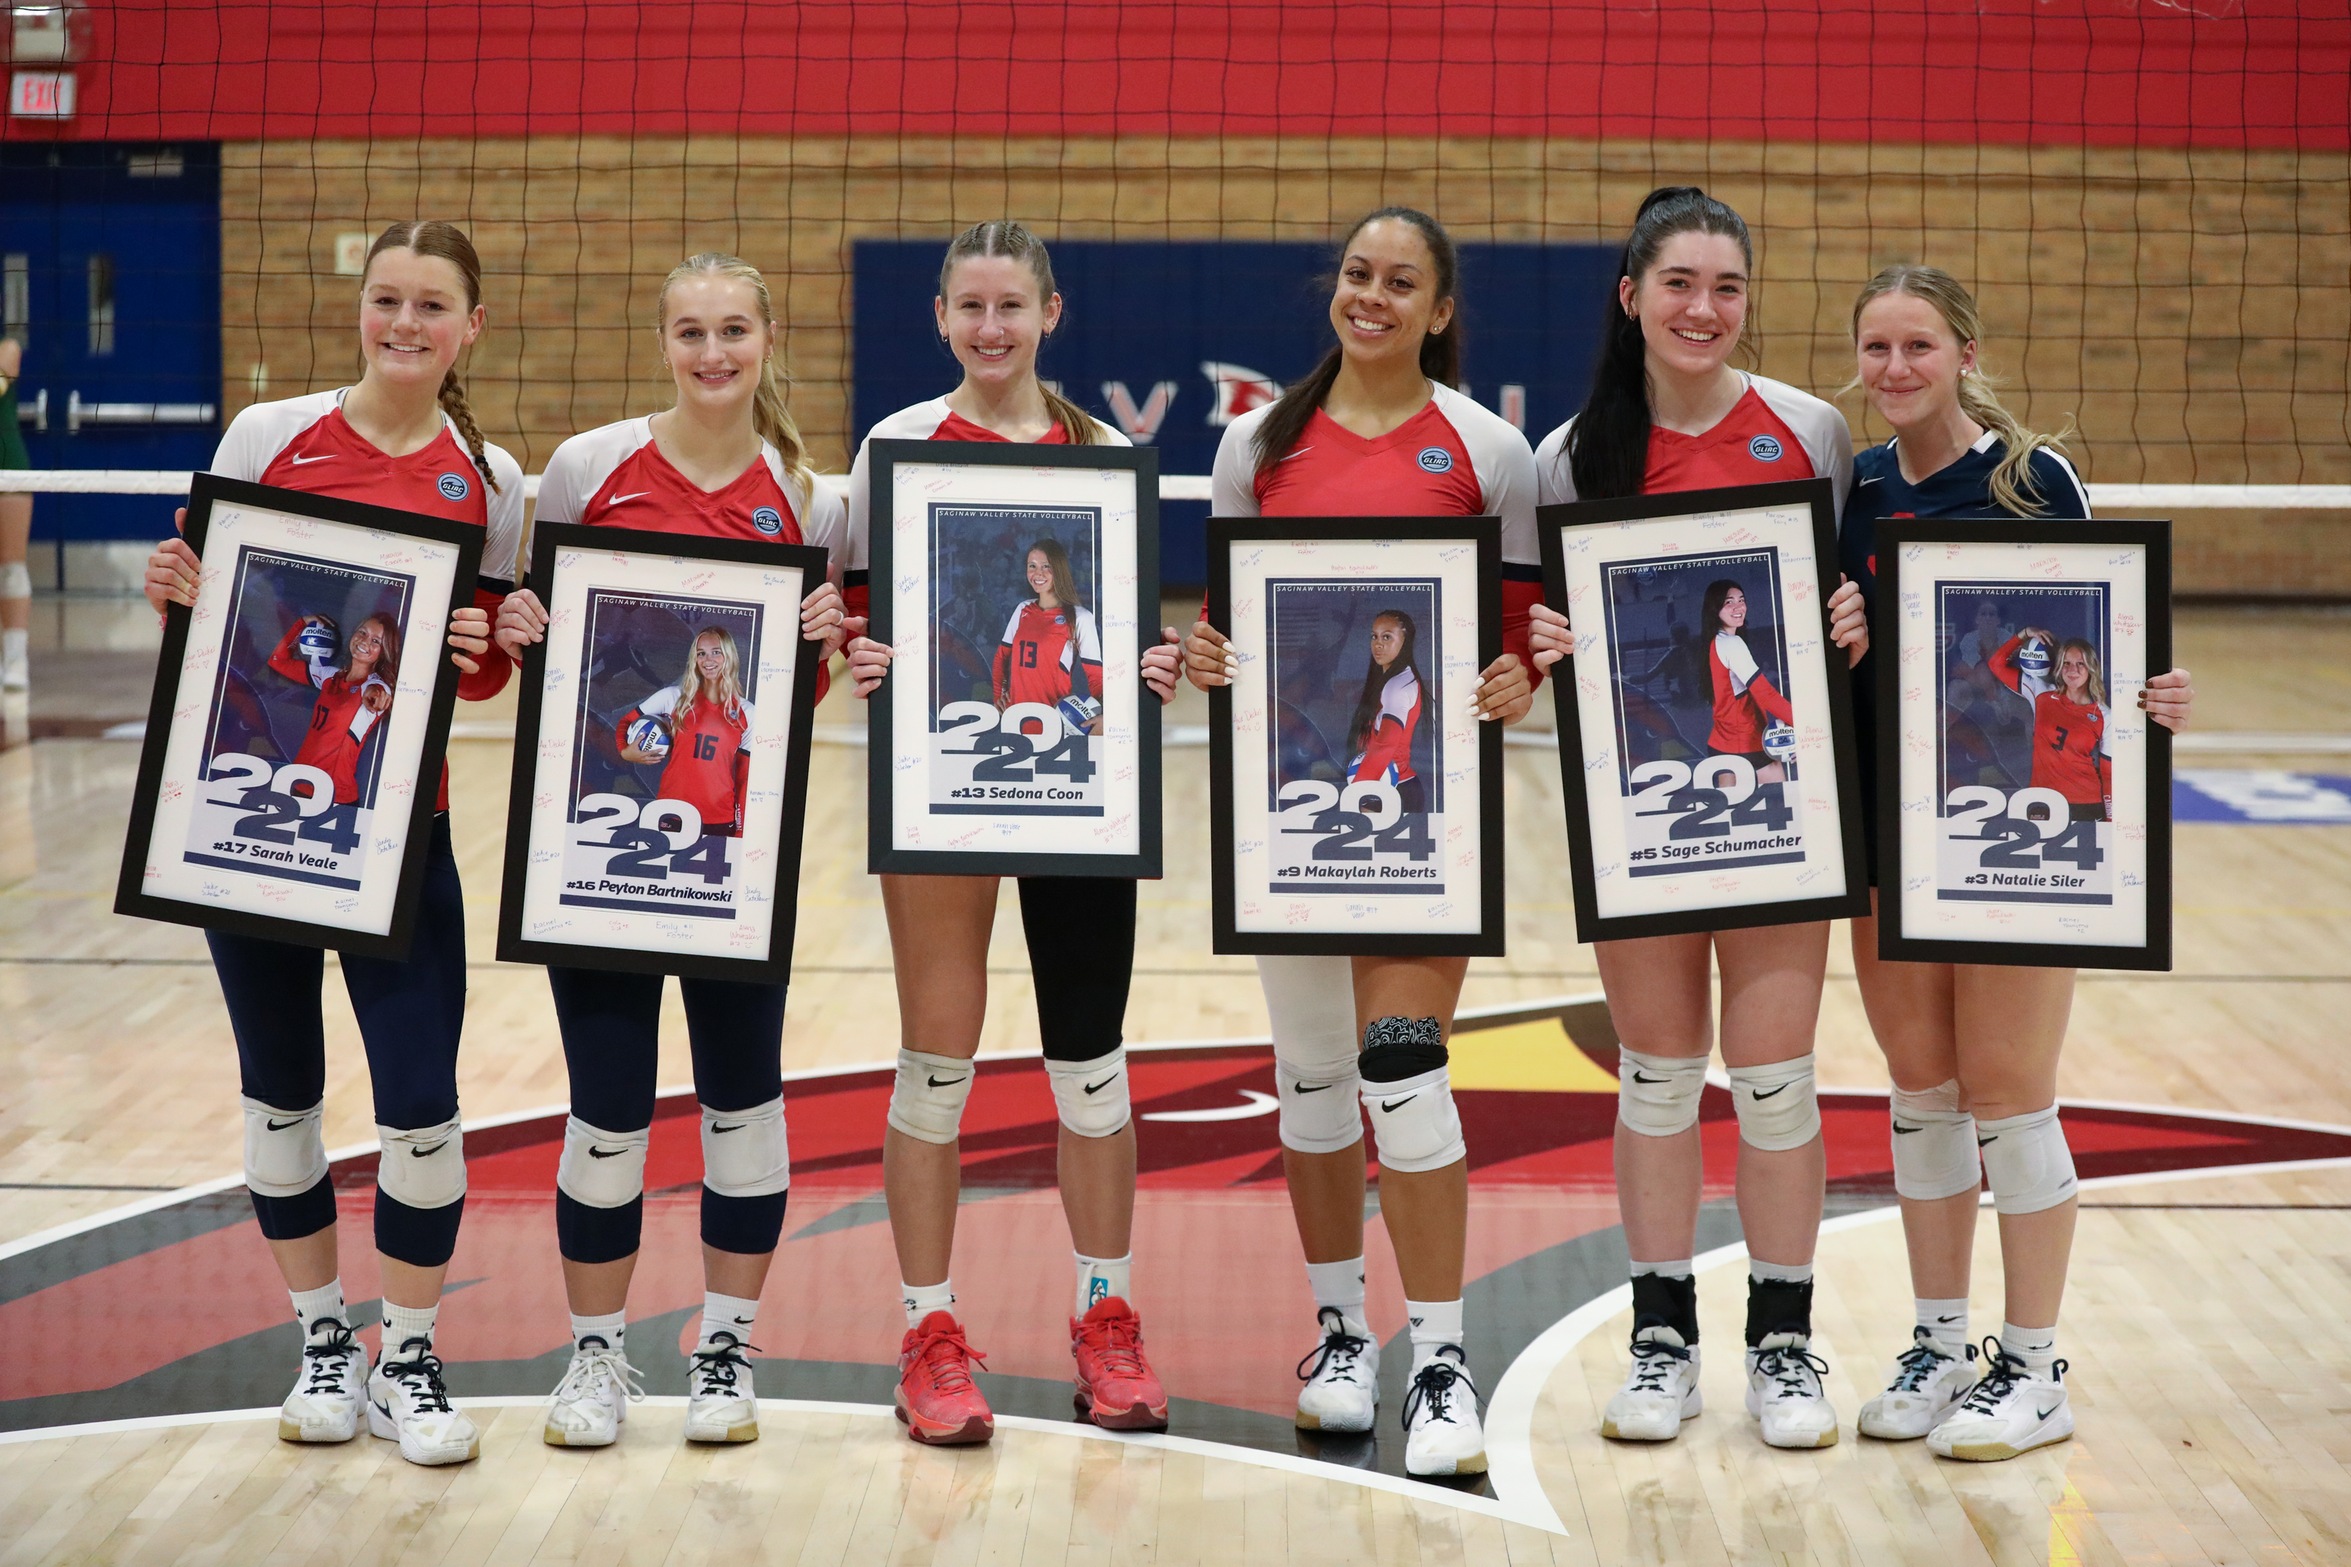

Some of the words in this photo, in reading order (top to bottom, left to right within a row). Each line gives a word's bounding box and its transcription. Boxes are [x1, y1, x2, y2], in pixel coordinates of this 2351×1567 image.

[1423, 457, 1448, 465] GLIAC
[442, 483, 464, 493] GLIAC
[757, 517, 779, 527] GLIAC
[1702, 521, 1728, 529] Foster
[287, 527, 314, 540] Foster
[249, 554, 288, 566] SAGINAW
[290, 561, 321, 573] VALLEY
[323, 568, 350, 578] STATE
[352, 573, 405, 588] VOLLEYBALL
[1612, 566, 1650, 576] SAGINAW
[1653, 563, 1684, 573] VALLEY
[1687, 559, 1712, 569] STATE
[1715, 555, 1768, 566] VOLLEYBALL
[598, 597, 637, 606] SAGINAW
[639, 601, 670, 609] VALLEY
[673, 604, 698, 612] STATE
[701, 606, 753, 617] VOLLEYBALL
[305, 628, 332, 638] molten
[1019, 640, 1038, 669] 13
[1070, 698, 1092, 719] molte
[312, 704, 330, 731] 17
[643, 731, 657, 753] molte
[693, 733, 720, 761] 16
[2051, 726, 2068, 751] 3
[951, 787, 985, 798] #13
[989, 787, 1043, 800] Sedona
[1047, 787, 1083, 800] Coon
[2116, 821, 2139, 833] Emily
[212, 841, 248, 855] #17
[250, 845, 294, 863] Sarah
[299, 852, 338, 870] Veale
[1630, 847, 1658, 861] #5
[1661, 844, 1701, 861] Sage
[1705, 835, 1802, 855] Schumacher
[1277, 866, 1301, 877] #9
[1304, 865, 1376, 880] Makaylah
[1380, 866, 1437, 878] Roberts
[1964, 873, 1988, 885] #3
[1992, 873, 2047, 887] Natalie
[2050, 875, 2086, 888] Siler
[566, 880, 596, 891] #16
[599, 880, 645, 898] Peyton
[647, 884, 733, 903] Bartnikowski
[656, 921, 678, 933] Emily
[666, 932, 694, 940] Foster
